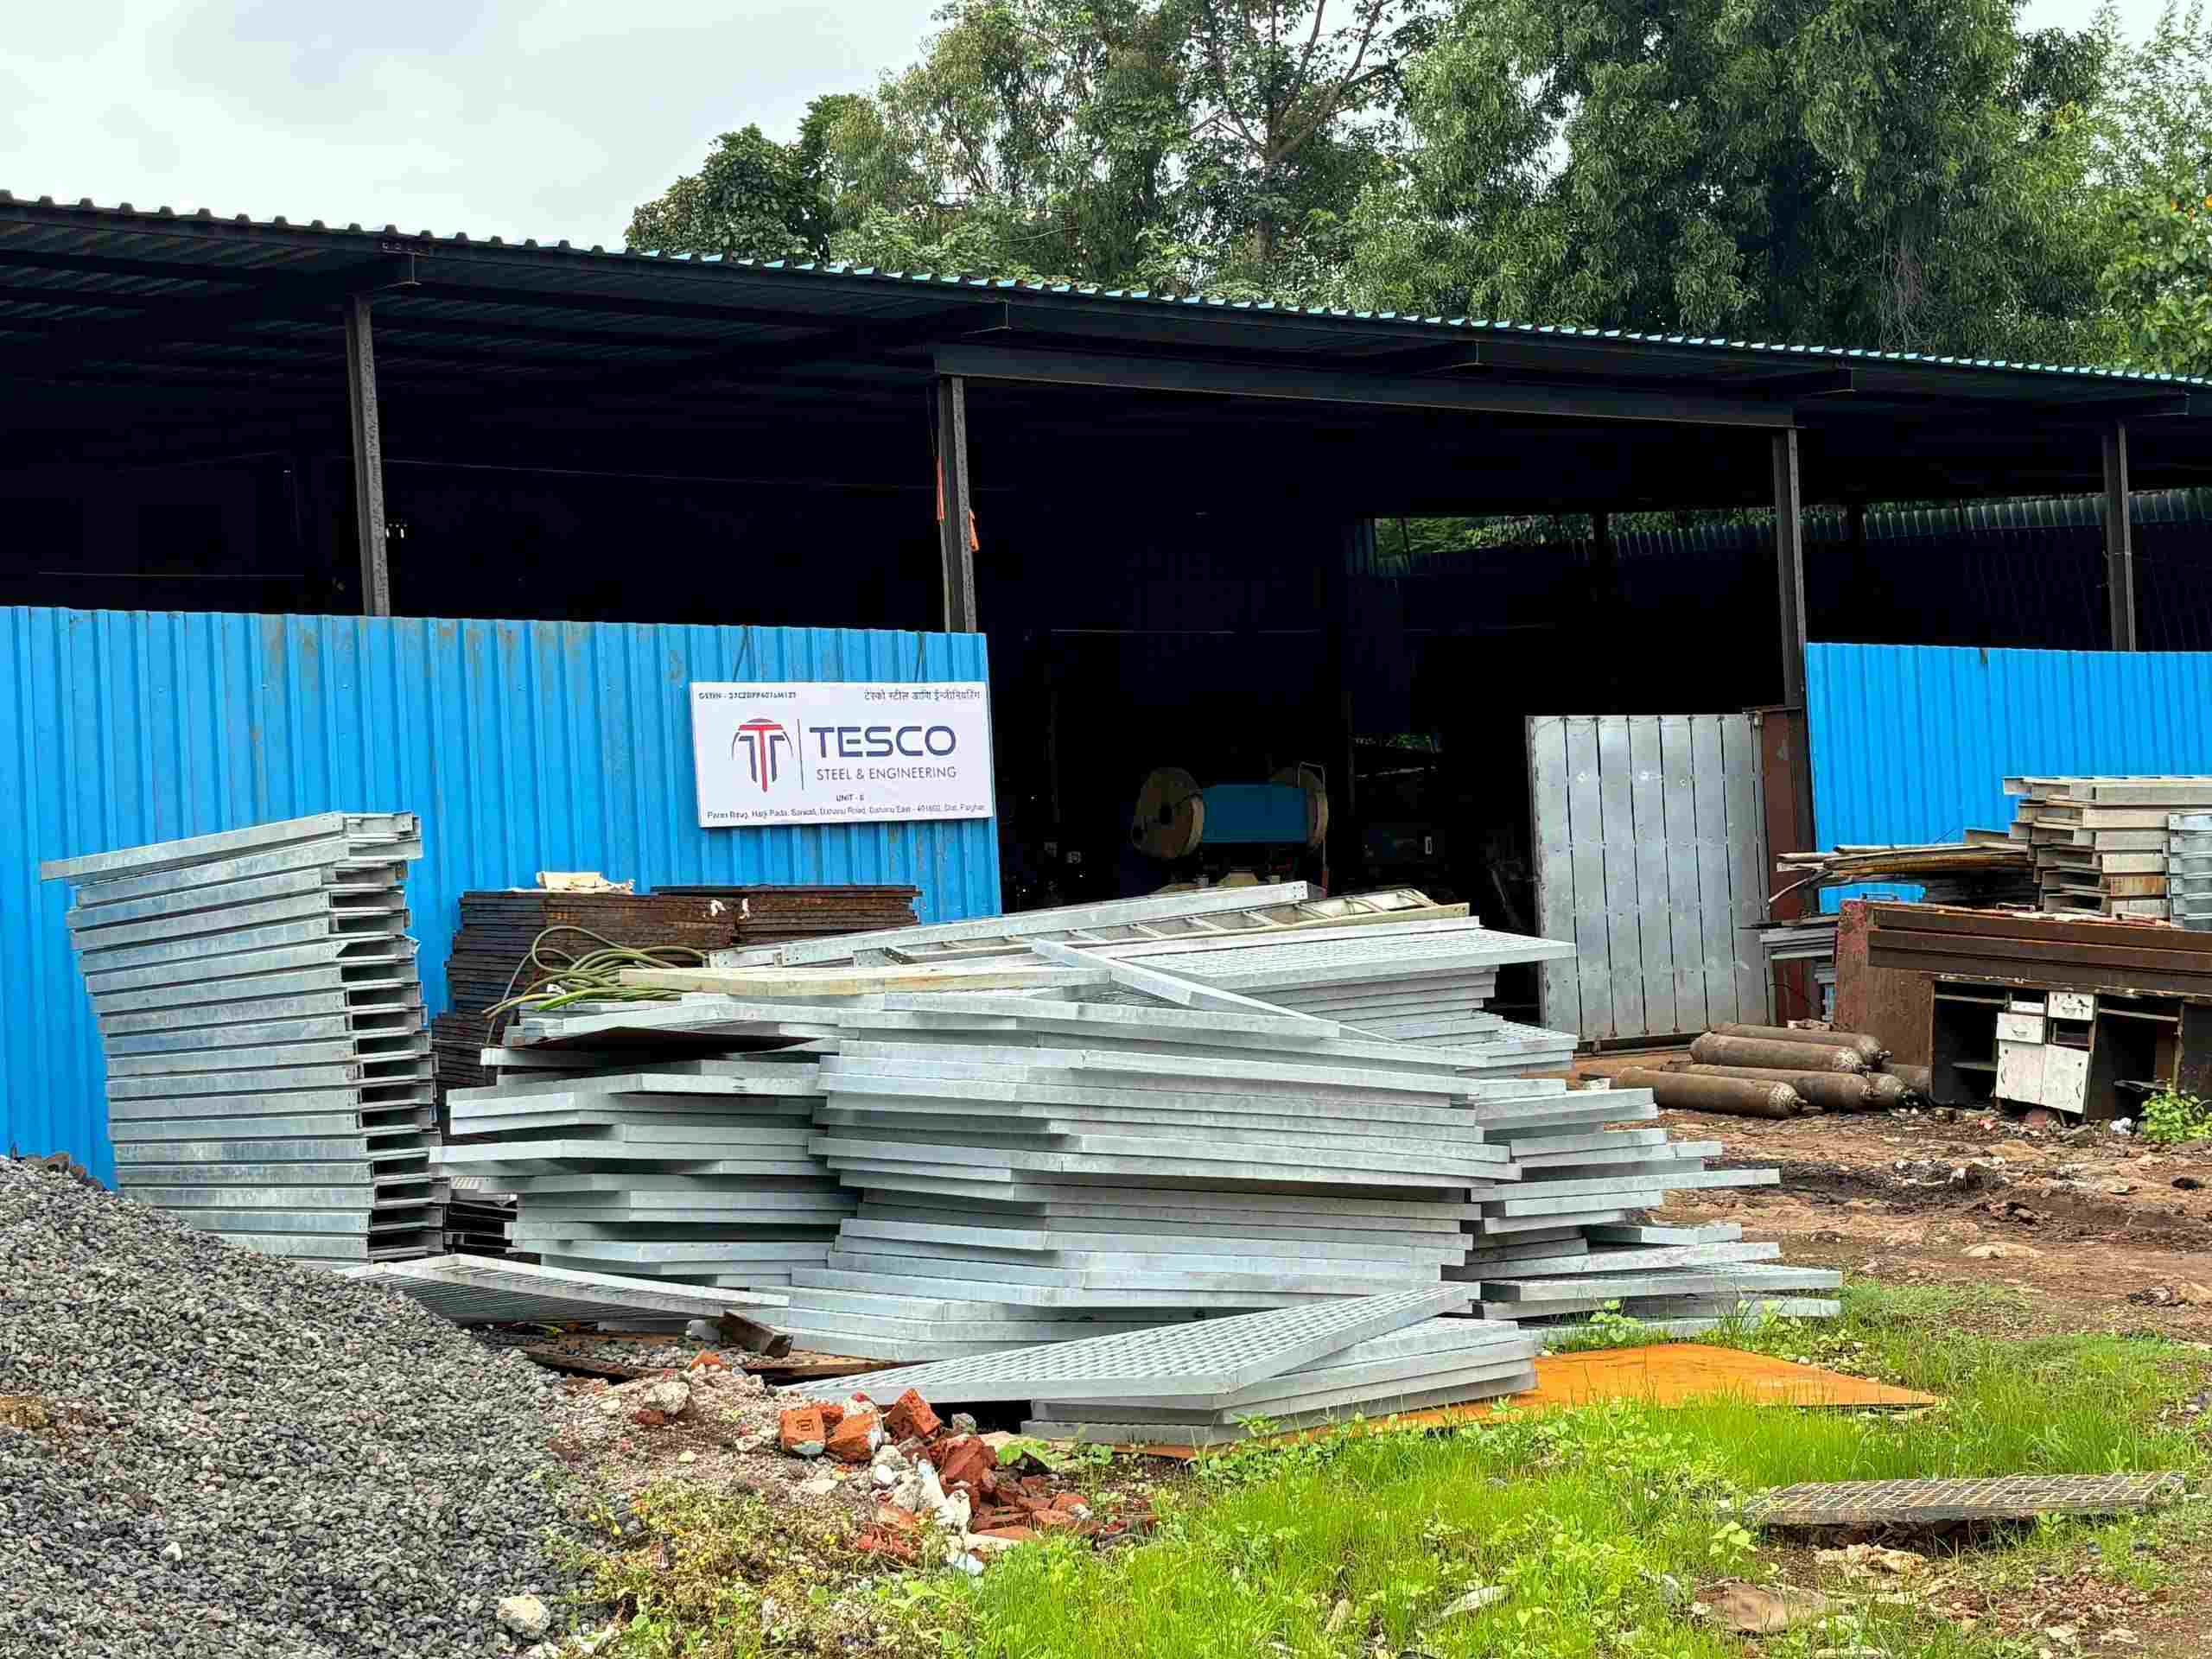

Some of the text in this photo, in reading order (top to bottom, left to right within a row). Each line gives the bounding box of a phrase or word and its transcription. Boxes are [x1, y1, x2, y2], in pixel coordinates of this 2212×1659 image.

[809, 726, 957, 758] TESCO
[817, 766, 957, 780] STEEL & ENGINEERING
